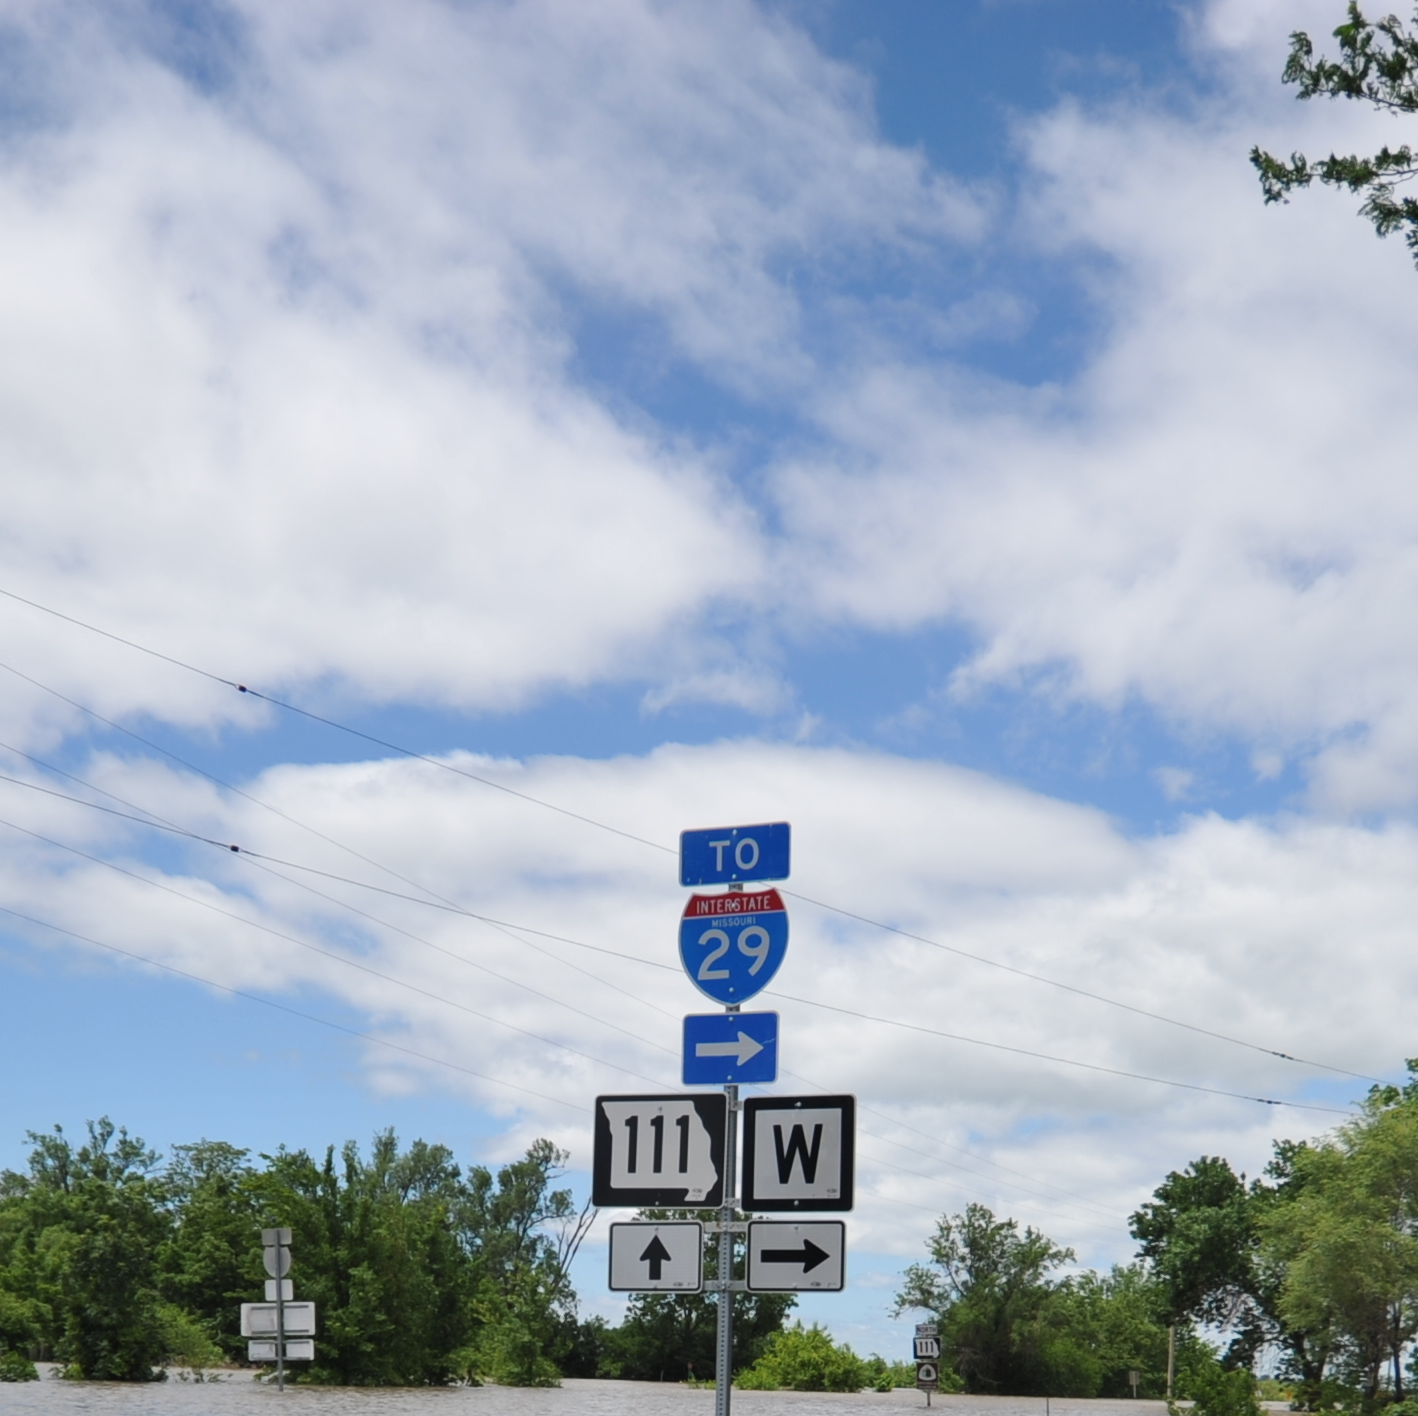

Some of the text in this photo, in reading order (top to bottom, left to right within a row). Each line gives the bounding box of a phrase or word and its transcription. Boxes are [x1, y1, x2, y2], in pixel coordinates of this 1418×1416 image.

[708, 837, 760, 872] TO
[696, 895, 771, 914] INTERSTATE
[711, 916, 756, 928] MISSOURI
[697, 925, 770, 981] 29
[624, 1114, 690, 1174] 111
[772, 1123, 824, 1185] W
[919, 1340, 934, 1354] 111
